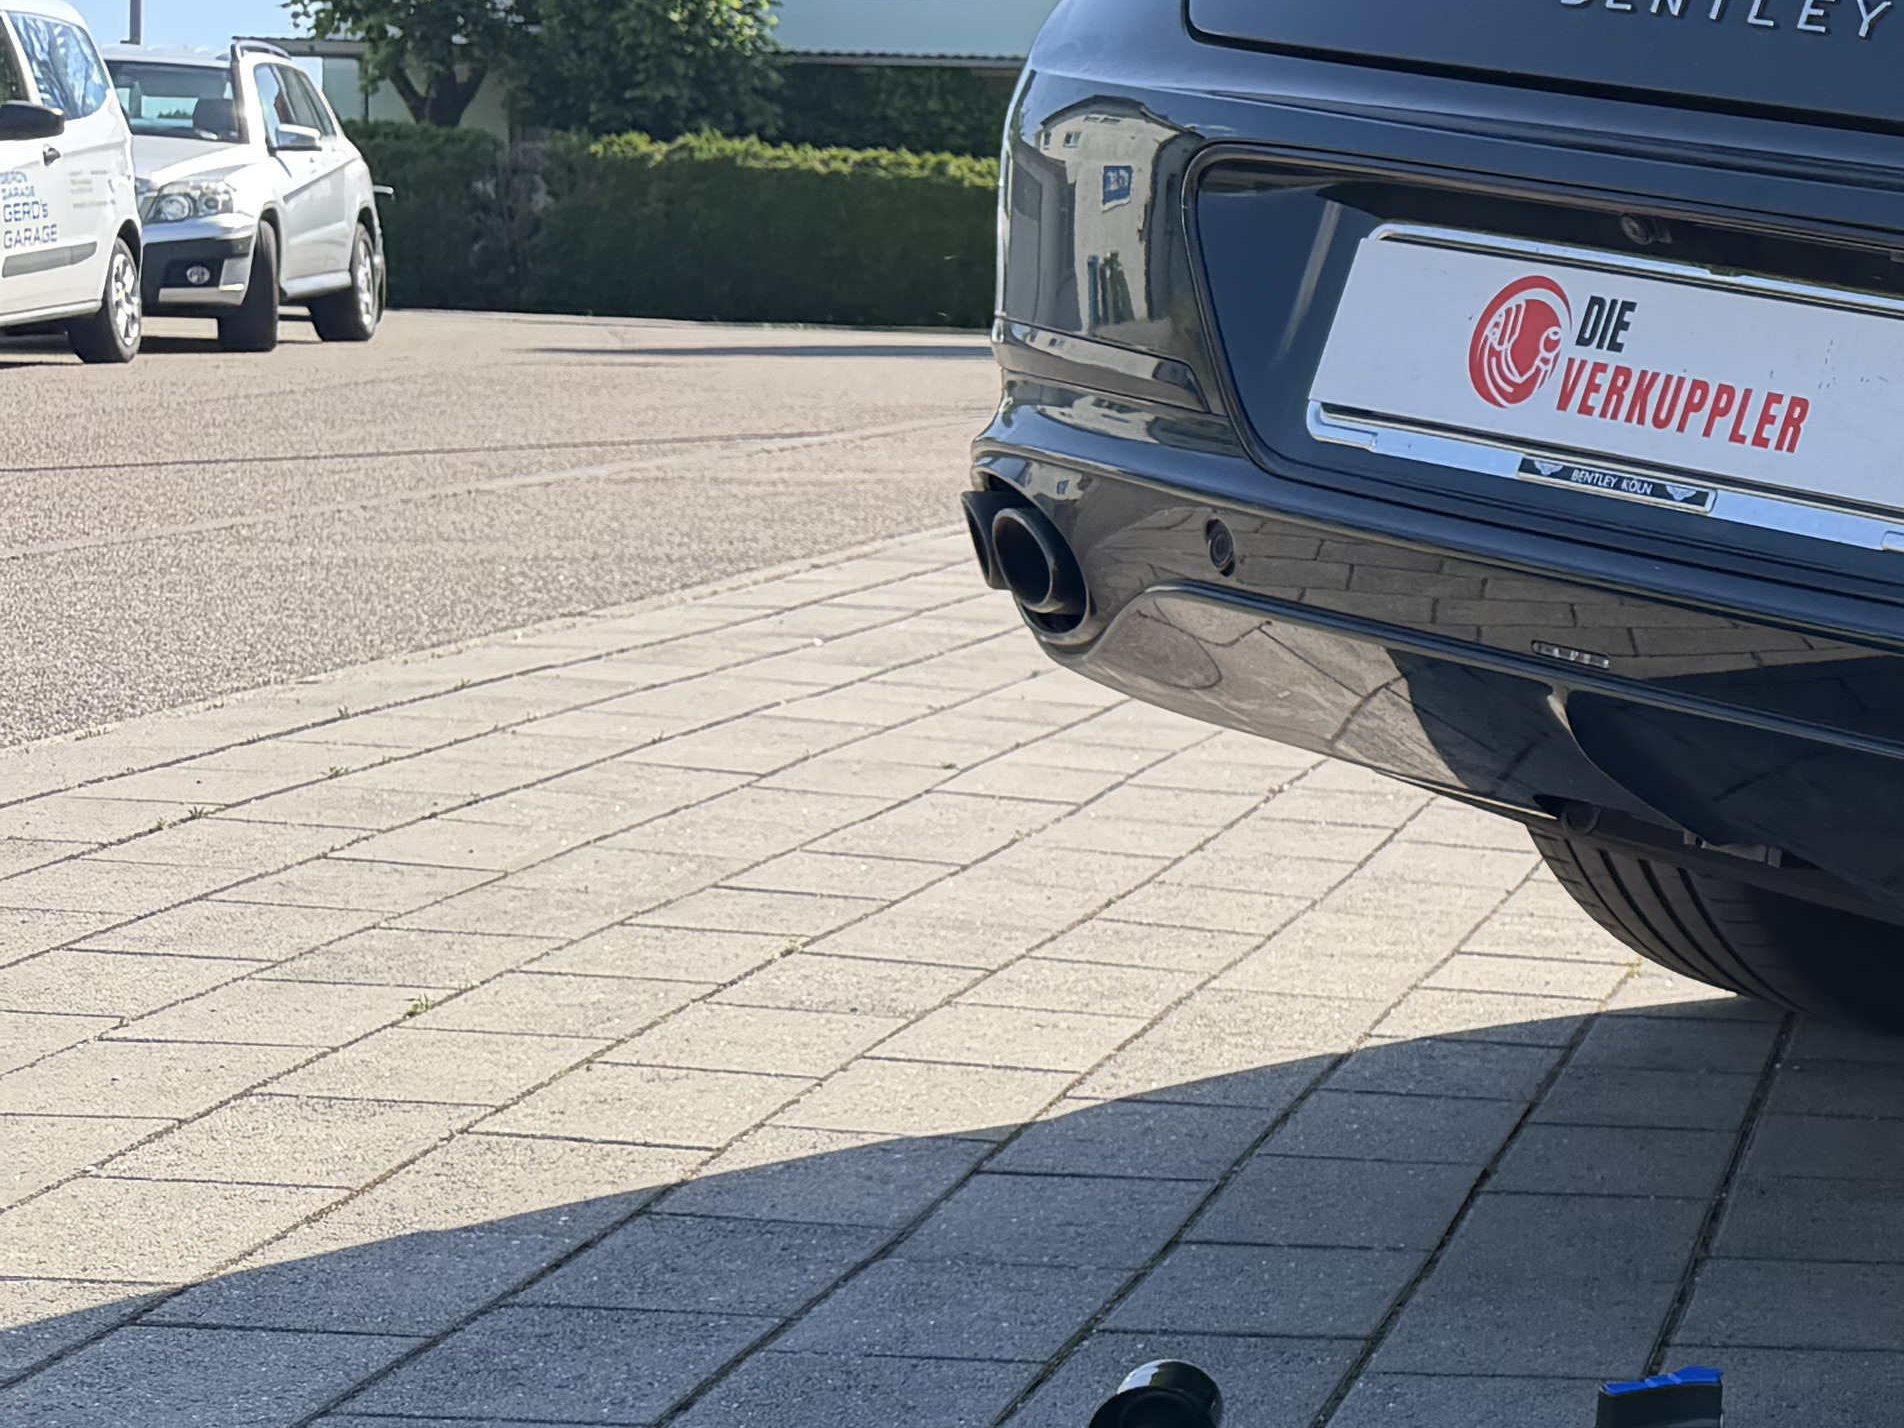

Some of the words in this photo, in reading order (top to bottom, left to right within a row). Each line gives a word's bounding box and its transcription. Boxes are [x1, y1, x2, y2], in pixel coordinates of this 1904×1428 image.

[3, 223, 58, 249] GARAGE
[1575, 295, 1638, 353] DIE
[1556, 357, 1810, 454] VERKUPPLER
[1571, 469, 1619, 488] BENTLEY
[1621, 476, 1654, 495] KÖLN
